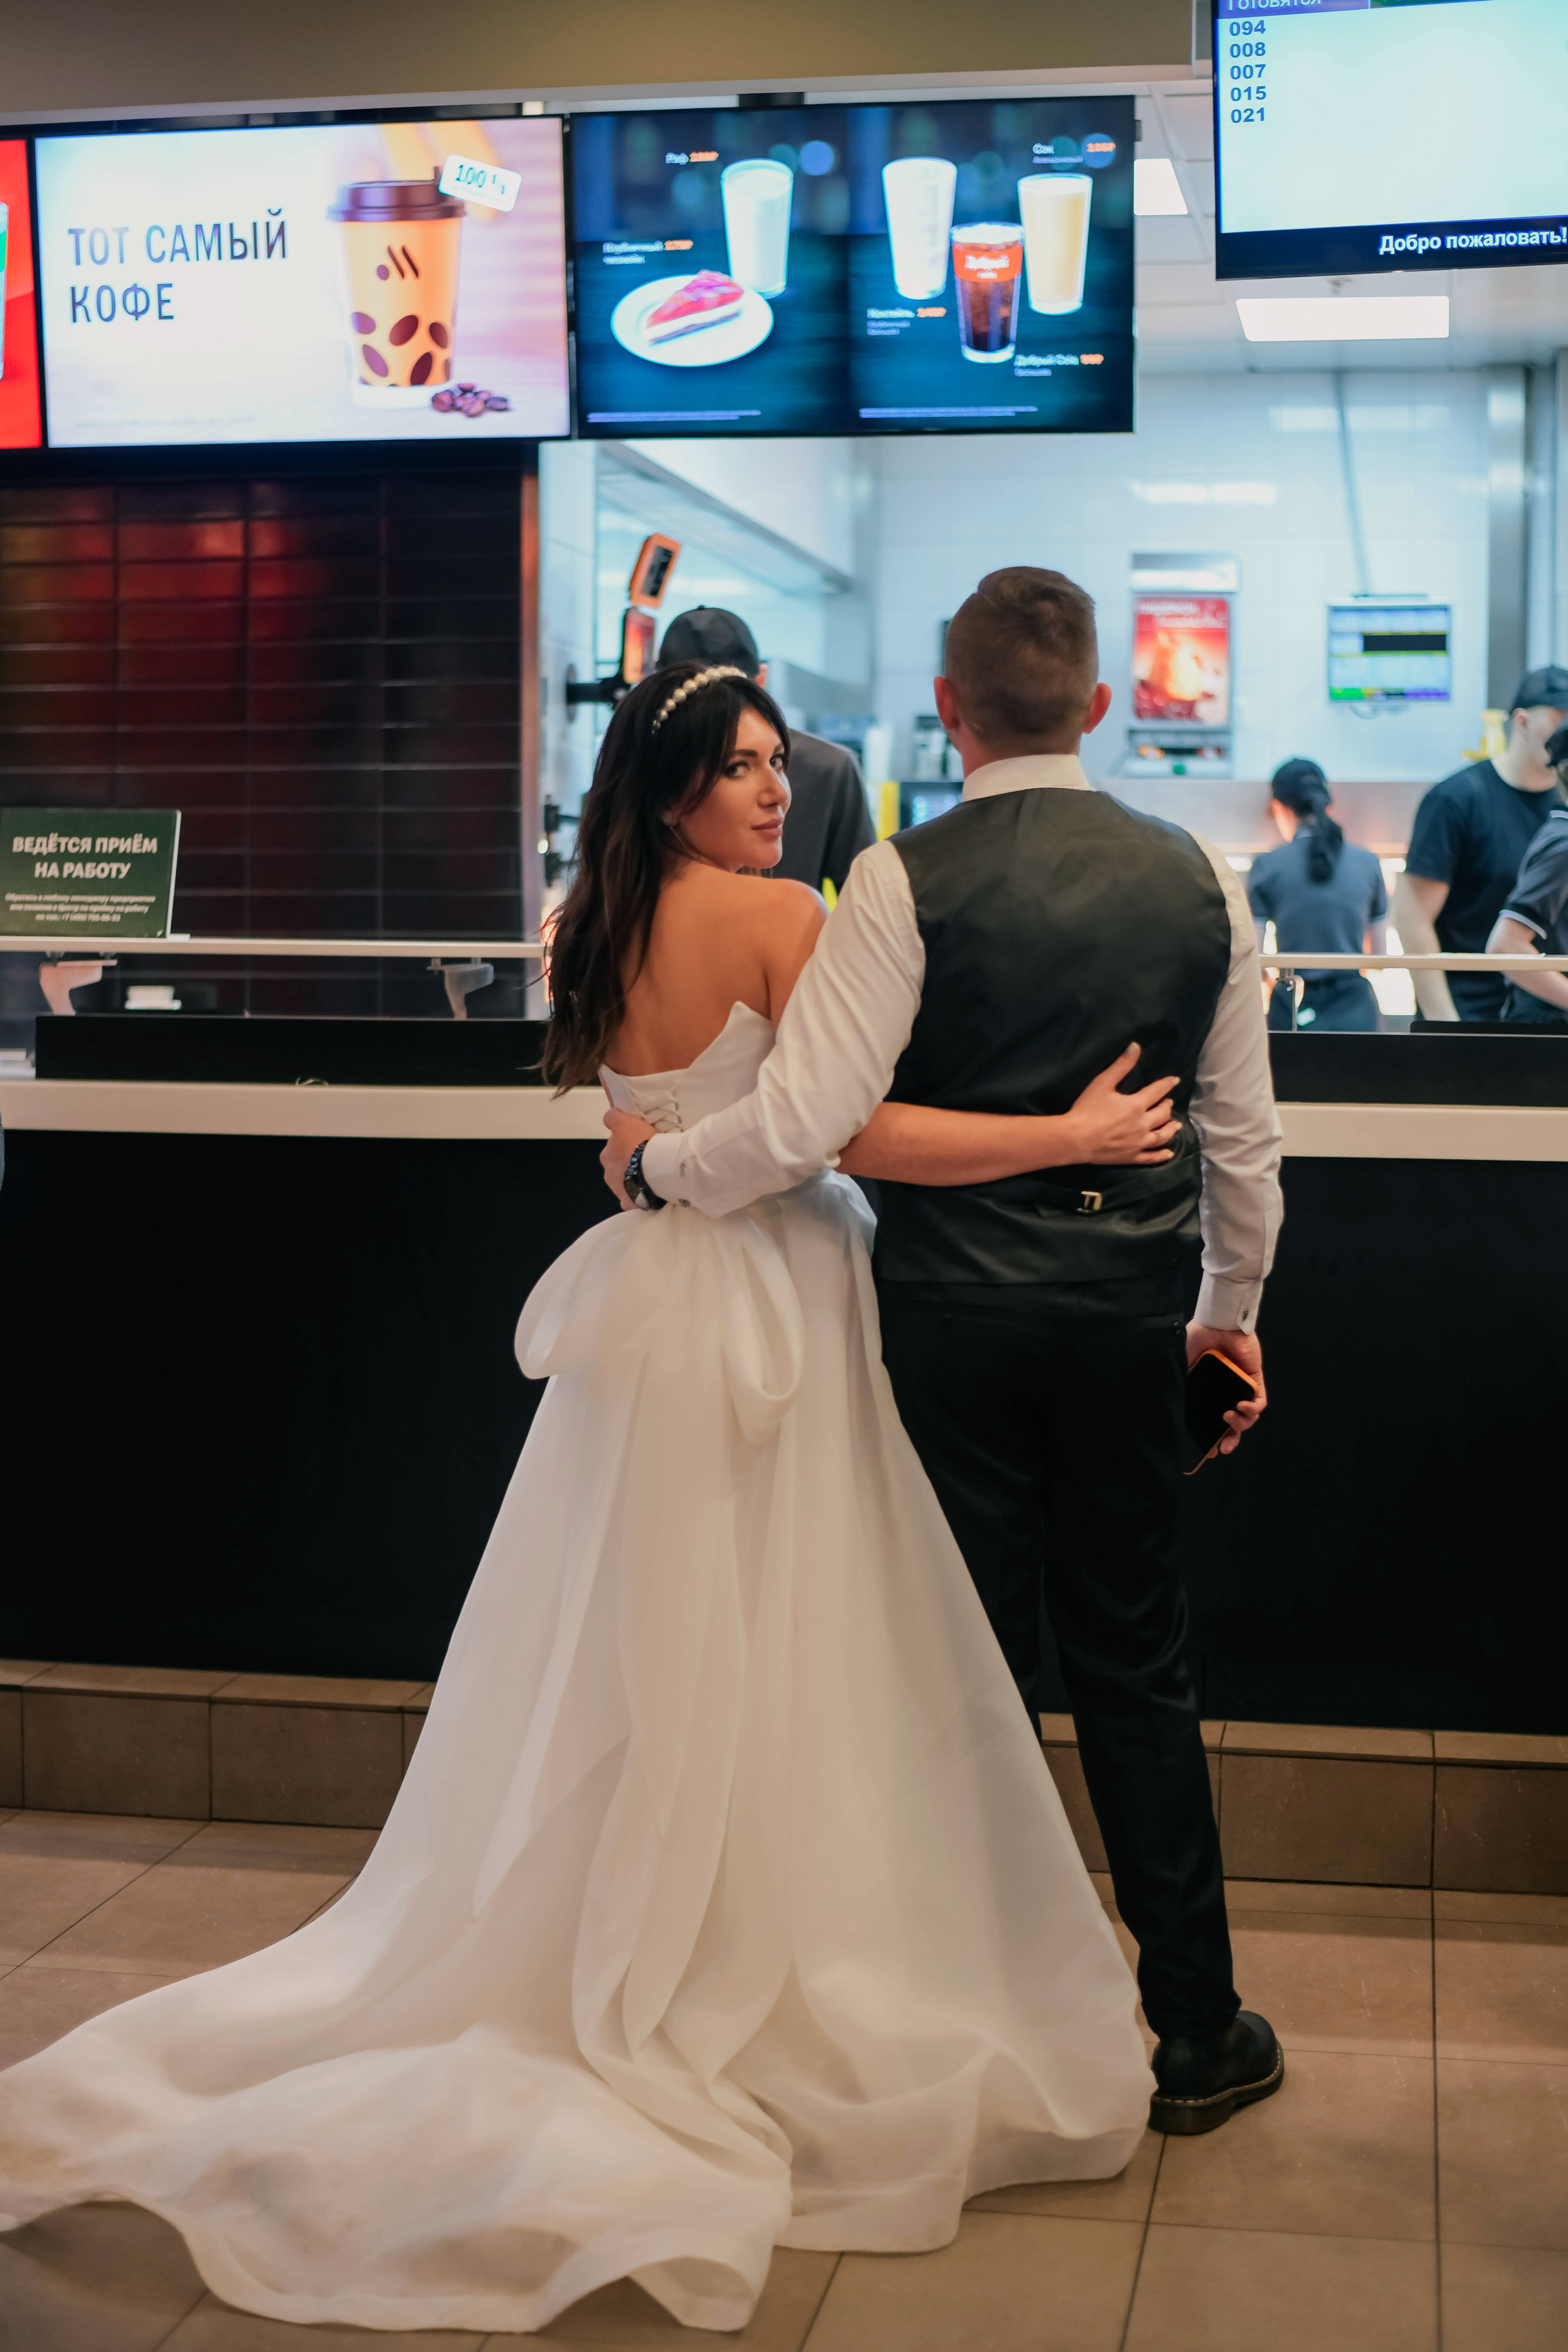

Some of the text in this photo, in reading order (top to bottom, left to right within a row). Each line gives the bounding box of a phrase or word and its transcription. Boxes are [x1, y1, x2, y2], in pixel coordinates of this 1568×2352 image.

[1229, 20, 1266, 36] 094
[1230, 42, 1266, 58] 008
[1230, 64, 1266, 80] 007
[1231, 86, 1267, 102] 015
[1231, 107, 1265, 124] 021
[68, 208, 286, 266] ТОТ САМЫЙ
[1378, 226, 1568, 255] Добро пожаловать!
[70, 283, 174, 323] КОФЕ
[12, 832, 157, 856] ВЕДЁТСЯ ПРИЁМ
[34, 861, 131, 879] НА РАБОТУ
